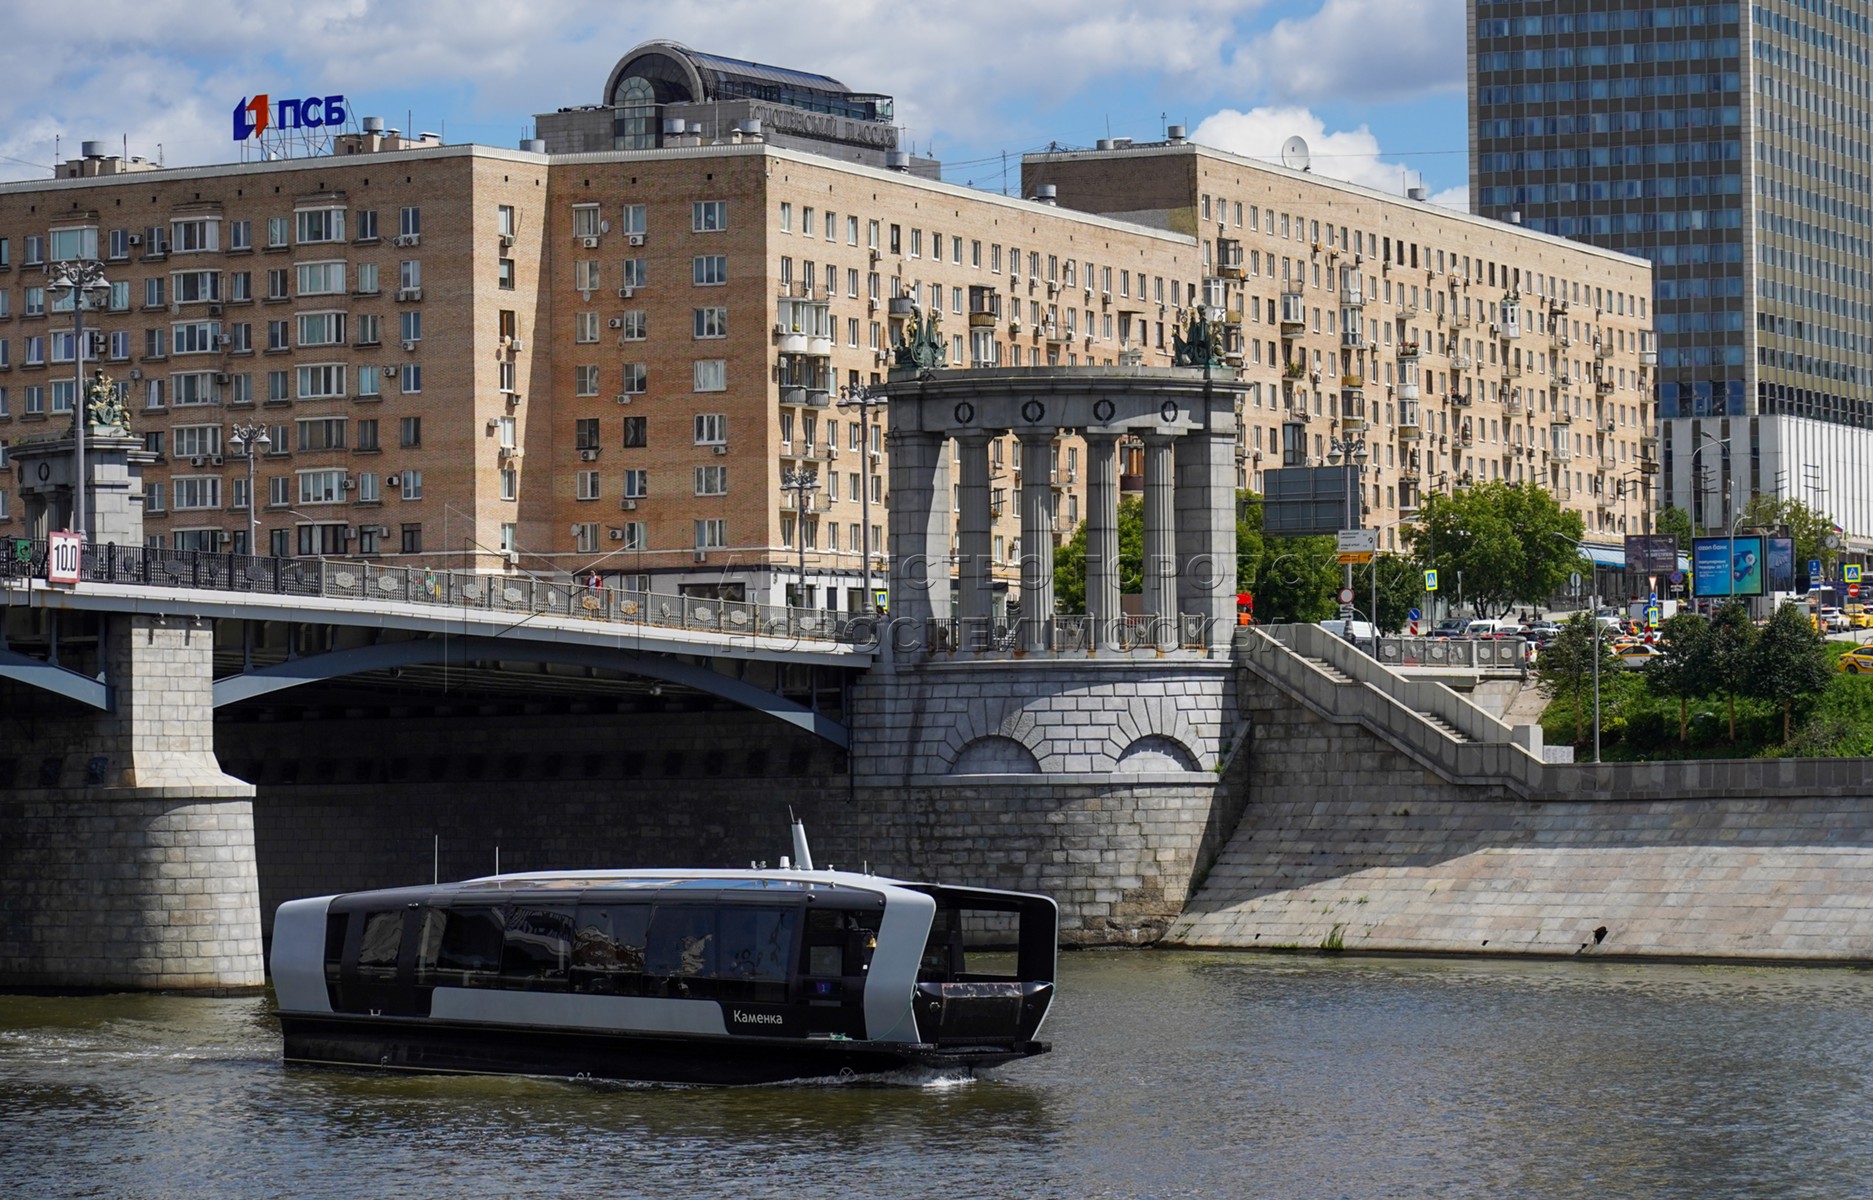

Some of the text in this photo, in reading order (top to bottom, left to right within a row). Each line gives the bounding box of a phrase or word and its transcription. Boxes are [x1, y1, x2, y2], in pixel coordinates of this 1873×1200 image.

[278, 95, 346, 130] ПСБ
[845, 121, 896, 149] ПАССАЖ
[54, 543, 78, 572] 10.0
[733, 1009, 783, 1024] Каменка
